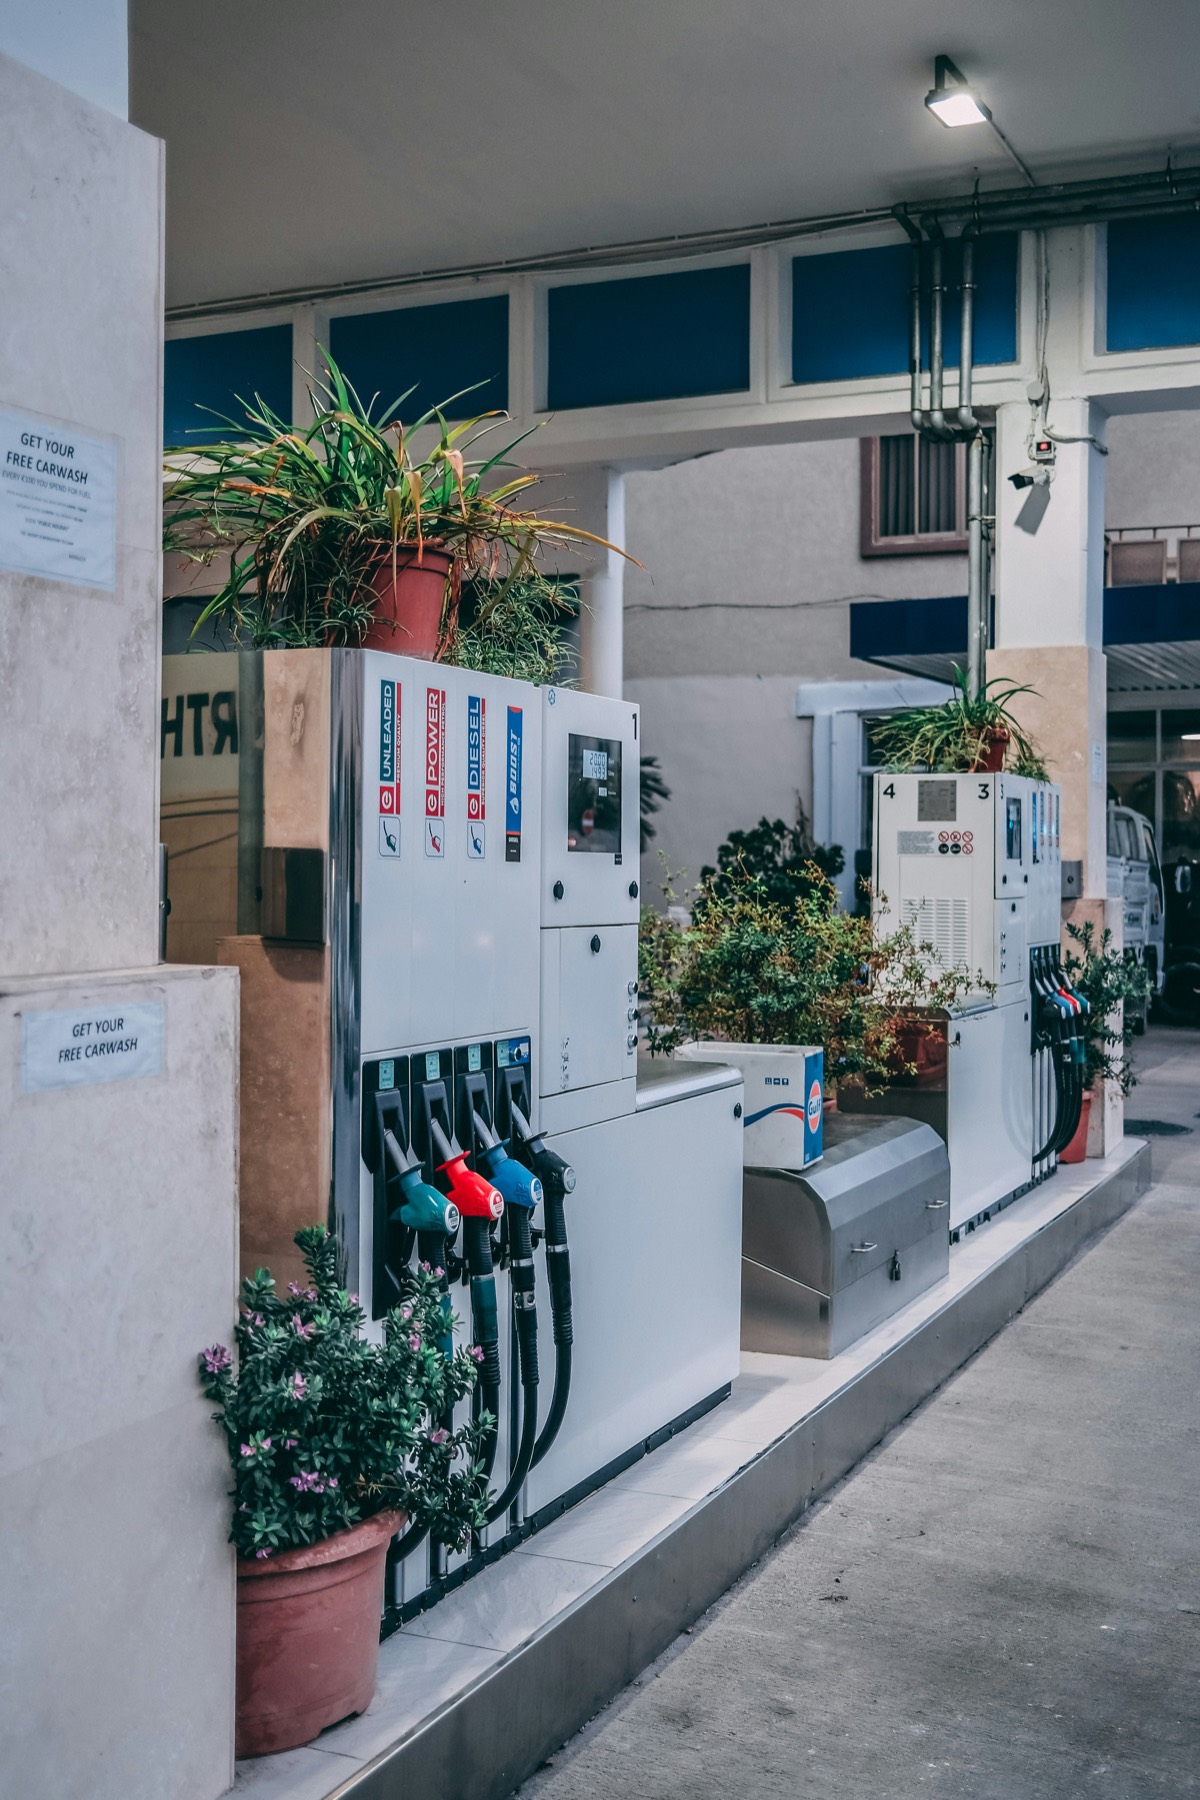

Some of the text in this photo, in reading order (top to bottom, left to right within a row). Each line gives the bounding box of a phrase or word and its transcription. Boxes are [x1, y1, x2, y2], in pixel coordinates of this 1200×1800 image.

[20, 433, 75, 459] GET YOUR
[6, 451, 89, 485] FREE CARWASH
[37, 479, 48, 489] YOU
[49, 482, 67, 493] SPEND
[67, 487, 78, 495] FOR
[79, 490, 91, 500] FUEL
[383, 685, 392, 778] UNLEADED
[428, 692, 438, 781] POWER
[632, 713, 637, 740] 1
[469, 701, 479, 786] DIESEL
[509, 729, 518, 794] BOOST
[882, 783, 896, 799] 4
[978, 783, 990, 800] 3
[72, 1017, 124, 1038] GET YOUR
[58, 1038, 138, 1063] FREE CARWASH
[808, 1098, 821, 1116] Gulf
